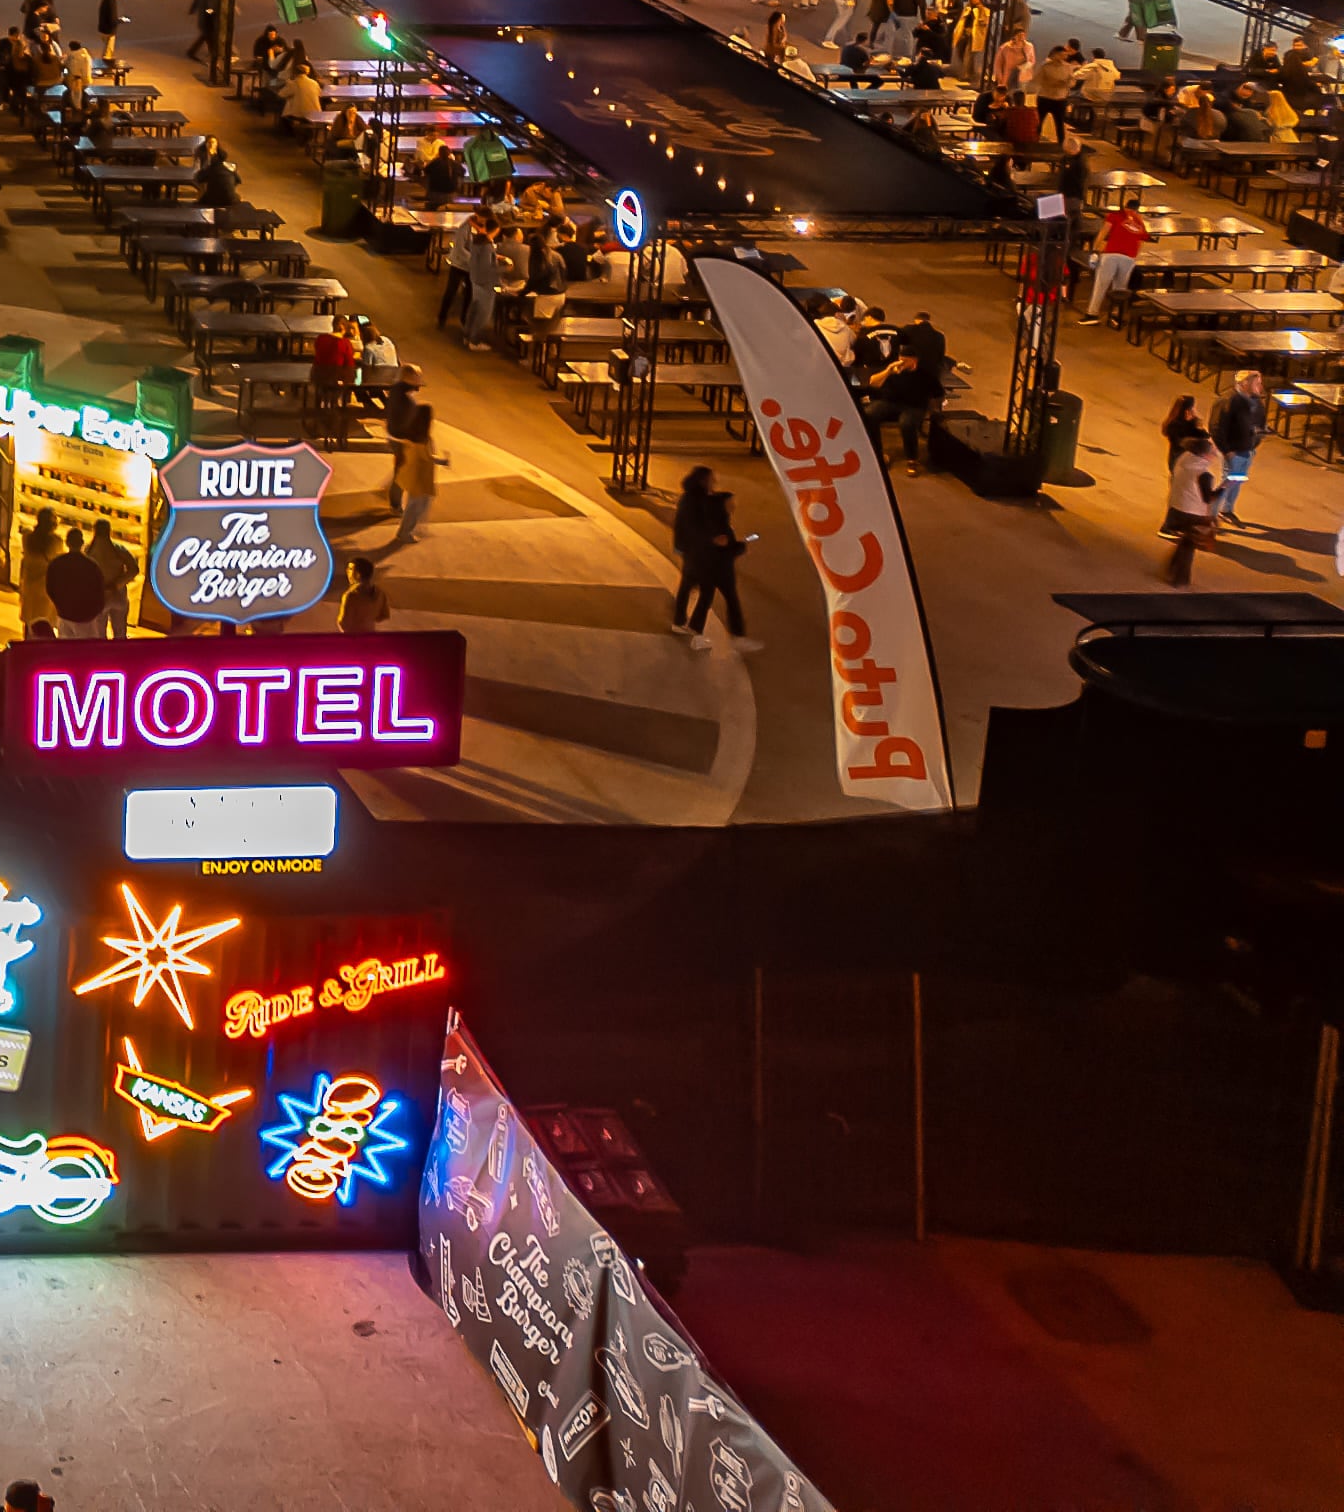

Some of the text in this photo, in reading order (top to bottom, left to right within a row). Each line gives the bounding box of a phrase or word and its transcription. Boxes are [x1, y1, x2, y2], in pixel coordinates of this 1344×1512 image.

[81, 405, 170, 460] Eats
[199, 459, 294, 498] ROUTE
[219, 512, 271, 551] The
[169, 538, 317, 578] Champions
[191, 570, 292, 609] Burger
[35, 665, 435, 750] MOTEL
[202, 858, 324, 876] ENJOY ON MODE
[318, 978, 343, 1009] &
[131, 1076, 209, 1124] KANSAS
[519, 1233, 551, 1289] The
[488, 1231, 574, 1350] Champions
[495, 1279, 561, 1365] Burger
